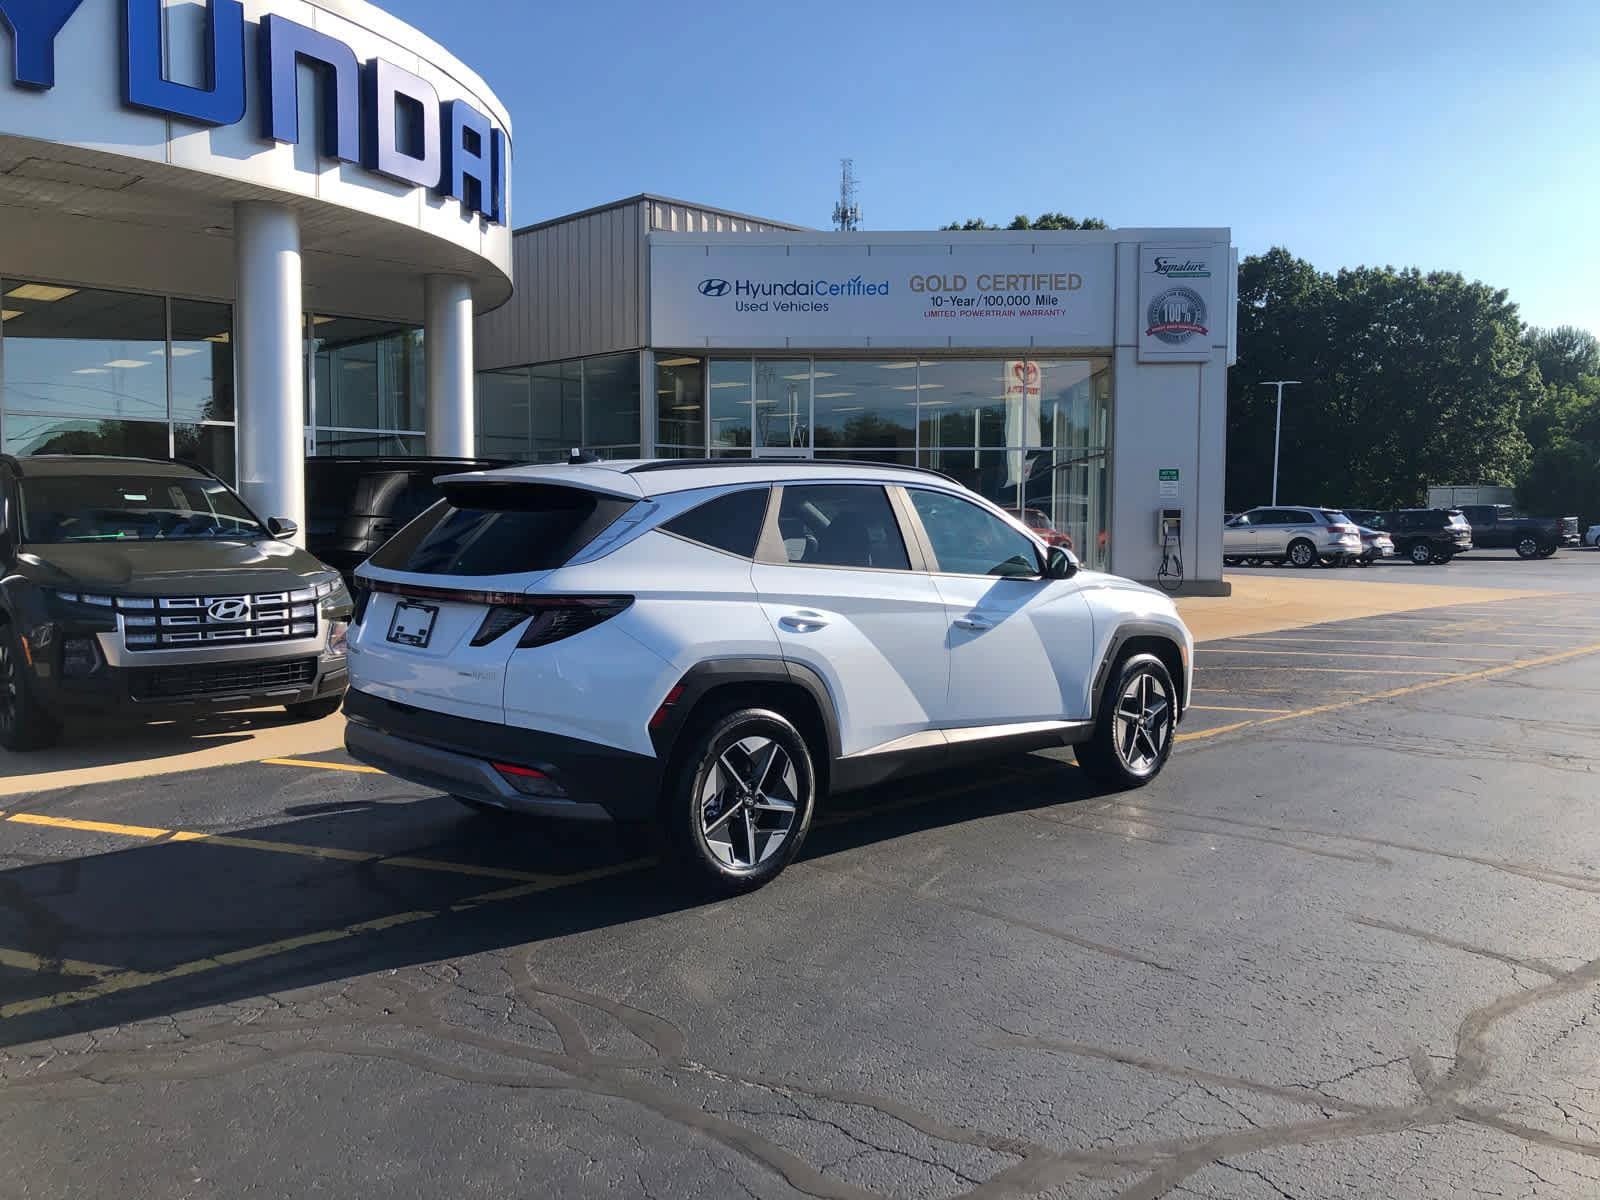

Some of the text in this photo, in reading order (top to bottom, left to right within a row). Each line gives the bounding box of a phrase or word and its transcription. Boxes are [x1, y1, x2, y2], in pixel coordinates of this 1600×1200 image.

[1153, 256, 1207, 275] Signature
[909, 273, 1082, 292] GOLD CERTIFIED
[735, 301, 829, 312] Used Vehicles
[931, 295, 1058, 307] 10-Year/100,000 Mile
[960, 310, 1016, 318] POWERTRAIN
[1019, 309, 1066, 317] WARRANTY
[1164, 303, 1191, 322] 100%
